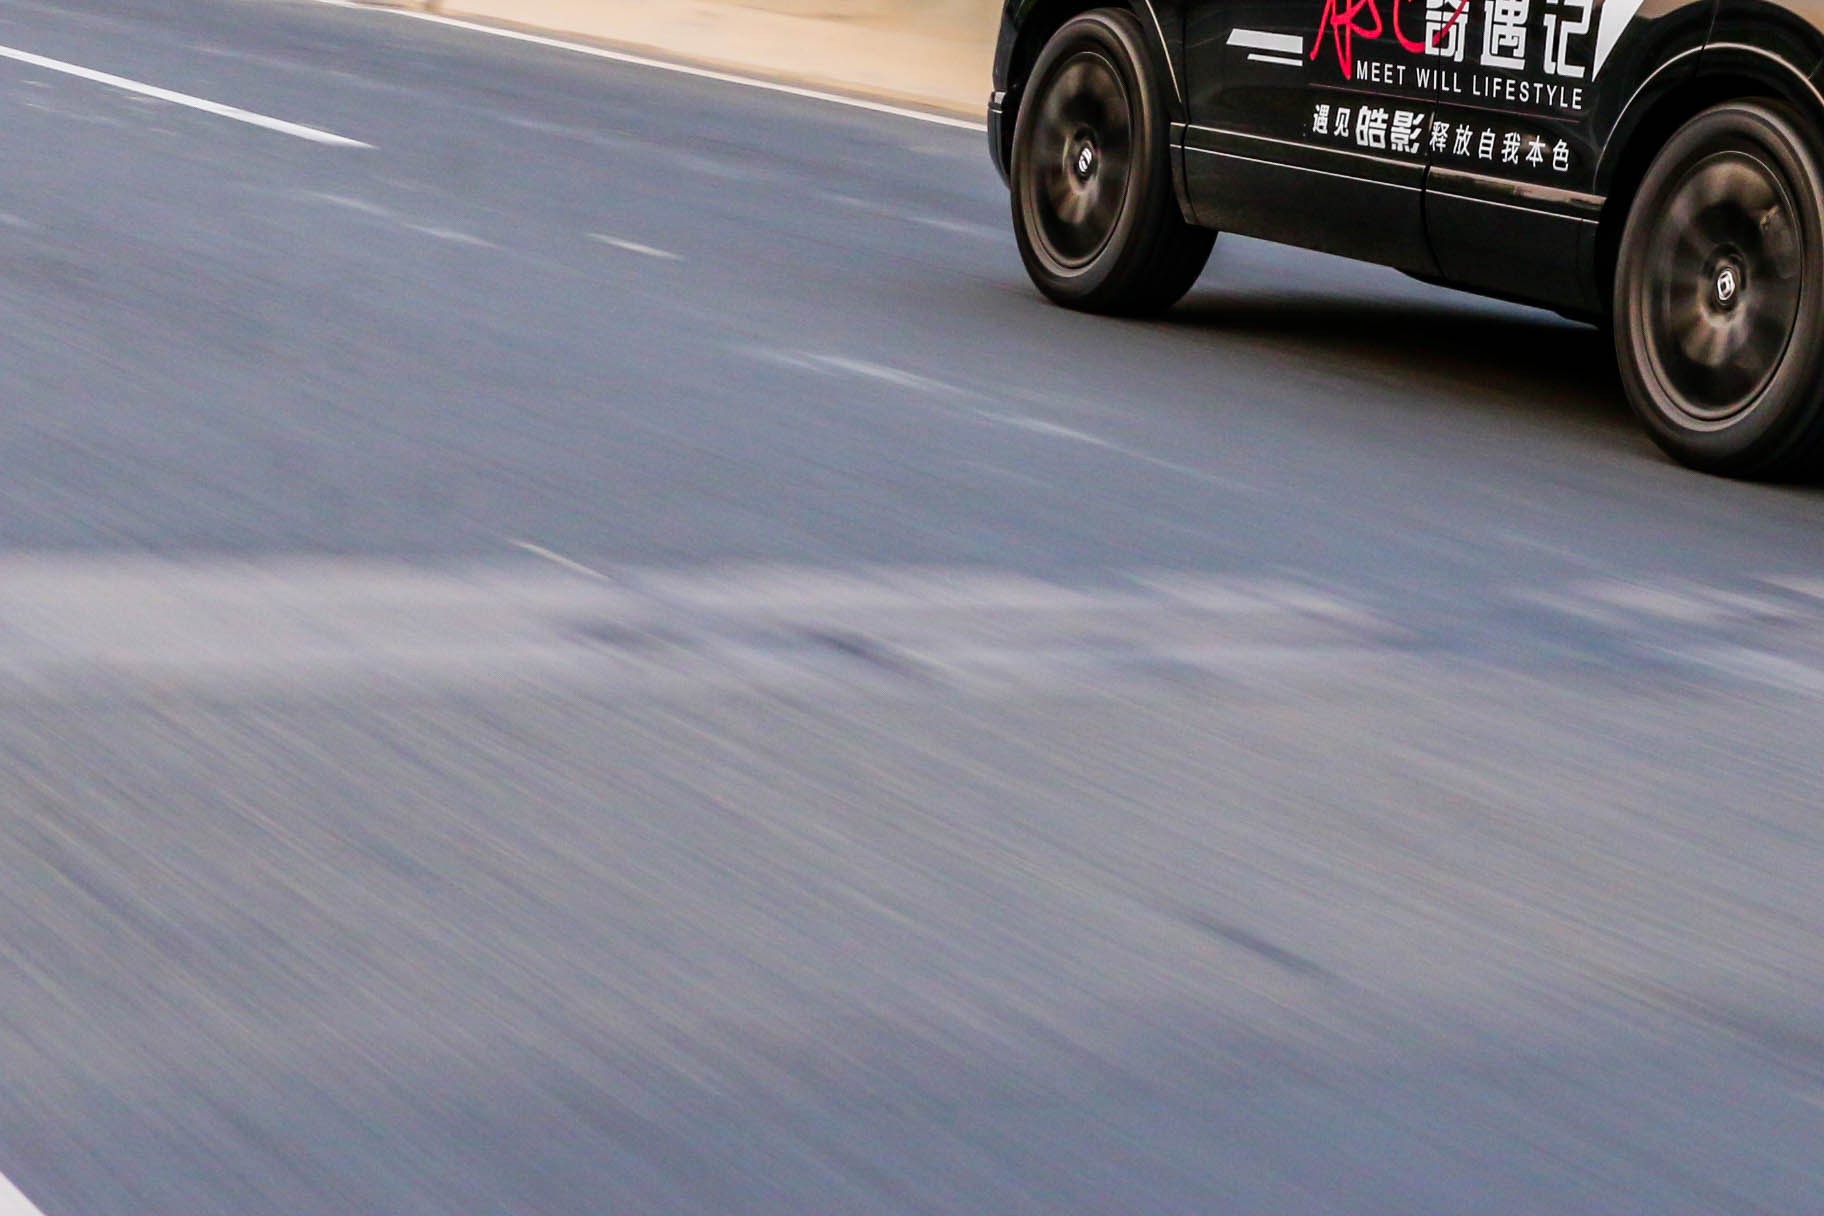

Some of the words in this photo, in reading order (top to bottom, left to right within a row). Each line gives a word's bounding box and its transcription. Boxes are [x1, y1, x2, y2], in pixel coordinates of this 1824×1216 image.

[1356, 60, 1406, 85] MEET
[1416, 67, 1462, 93] WILL
[1472, 74, 1583, 110] LIFESTYLE
[1312, 103, 1570, 172] 遇见皓影释放自我本色
